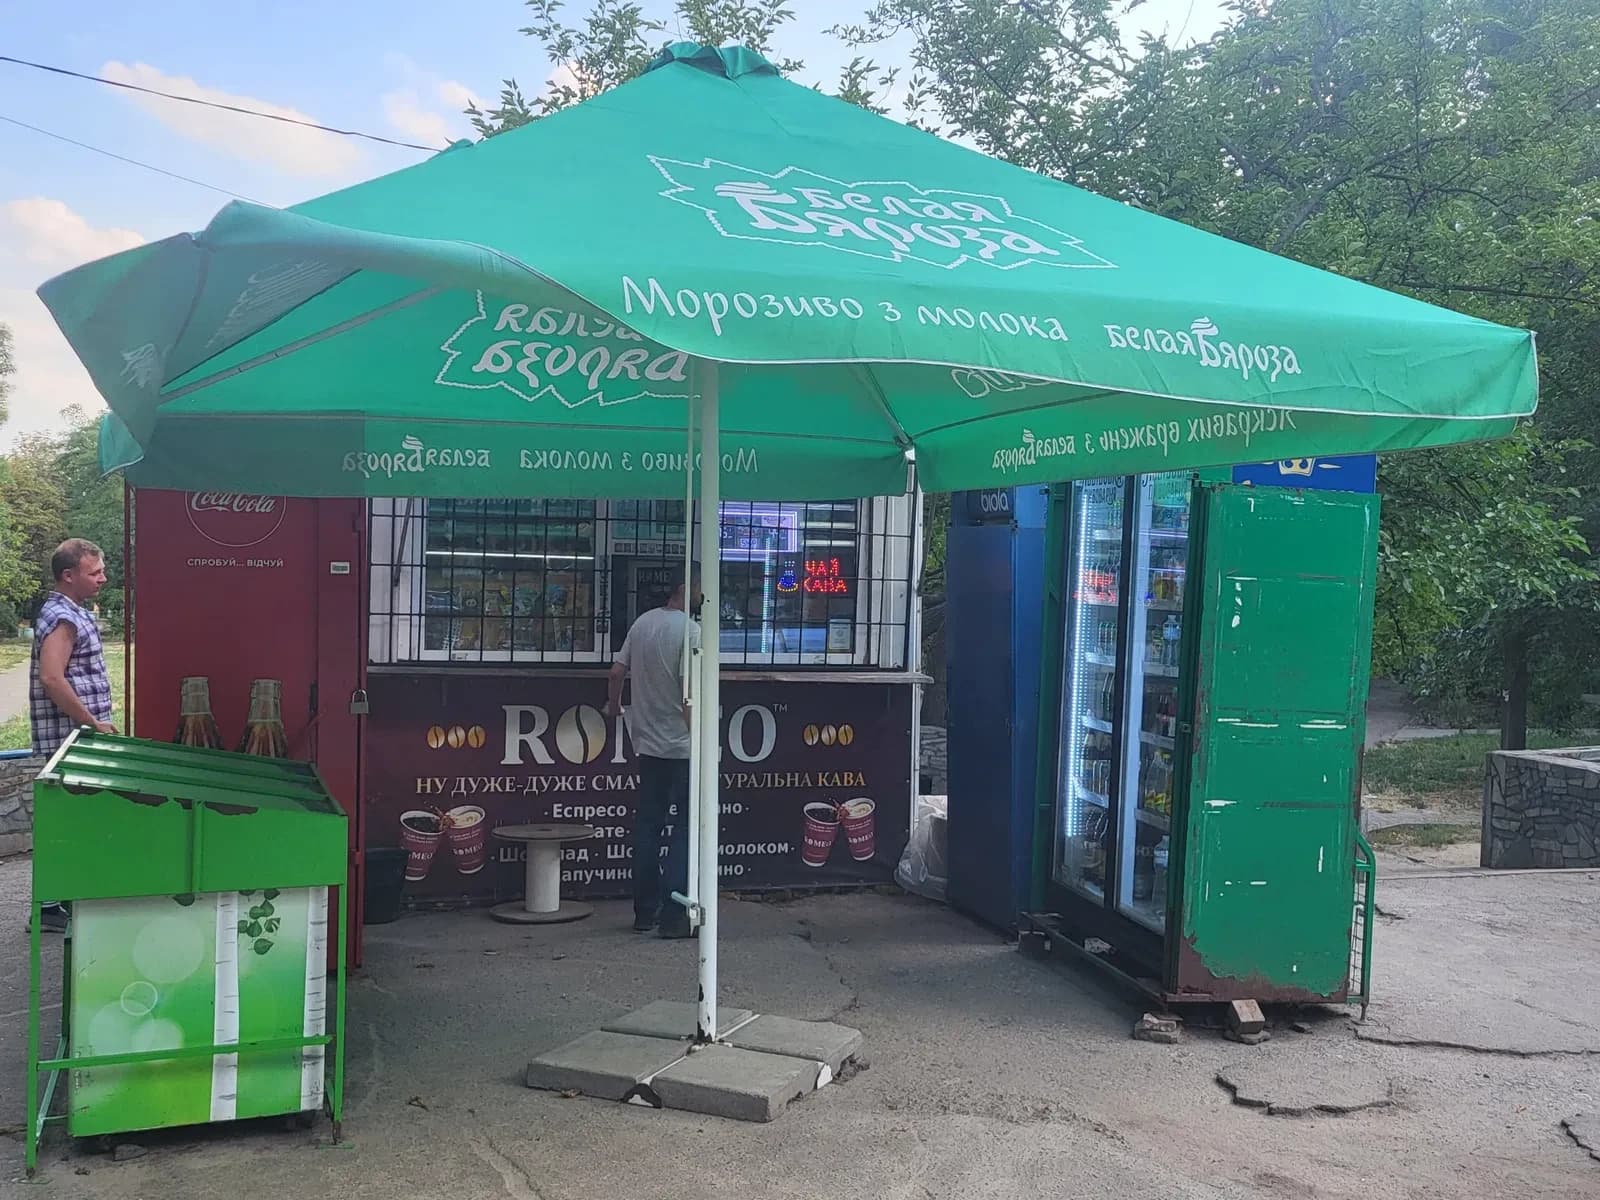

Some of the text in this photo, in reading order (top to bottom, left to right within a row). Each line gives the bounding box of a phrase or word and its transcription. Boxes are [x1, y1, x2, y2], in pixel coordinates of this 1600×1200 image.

[622, 275, 864, 337] Морозиво
[878, 301, 901, 322] з
[917, 305, 1069, 342] молока
[246, 557, 284, 567] ВІДЧУЙ
[500, 704, 777, 765] ROO
[415, 777, 448, 794] НУ
[451, 775, 586, 798] ДУЖЕ-ДУЖЕ
[817, 771, 866, 787] КАВА
[552, 803, 627, 820] Еспресо
